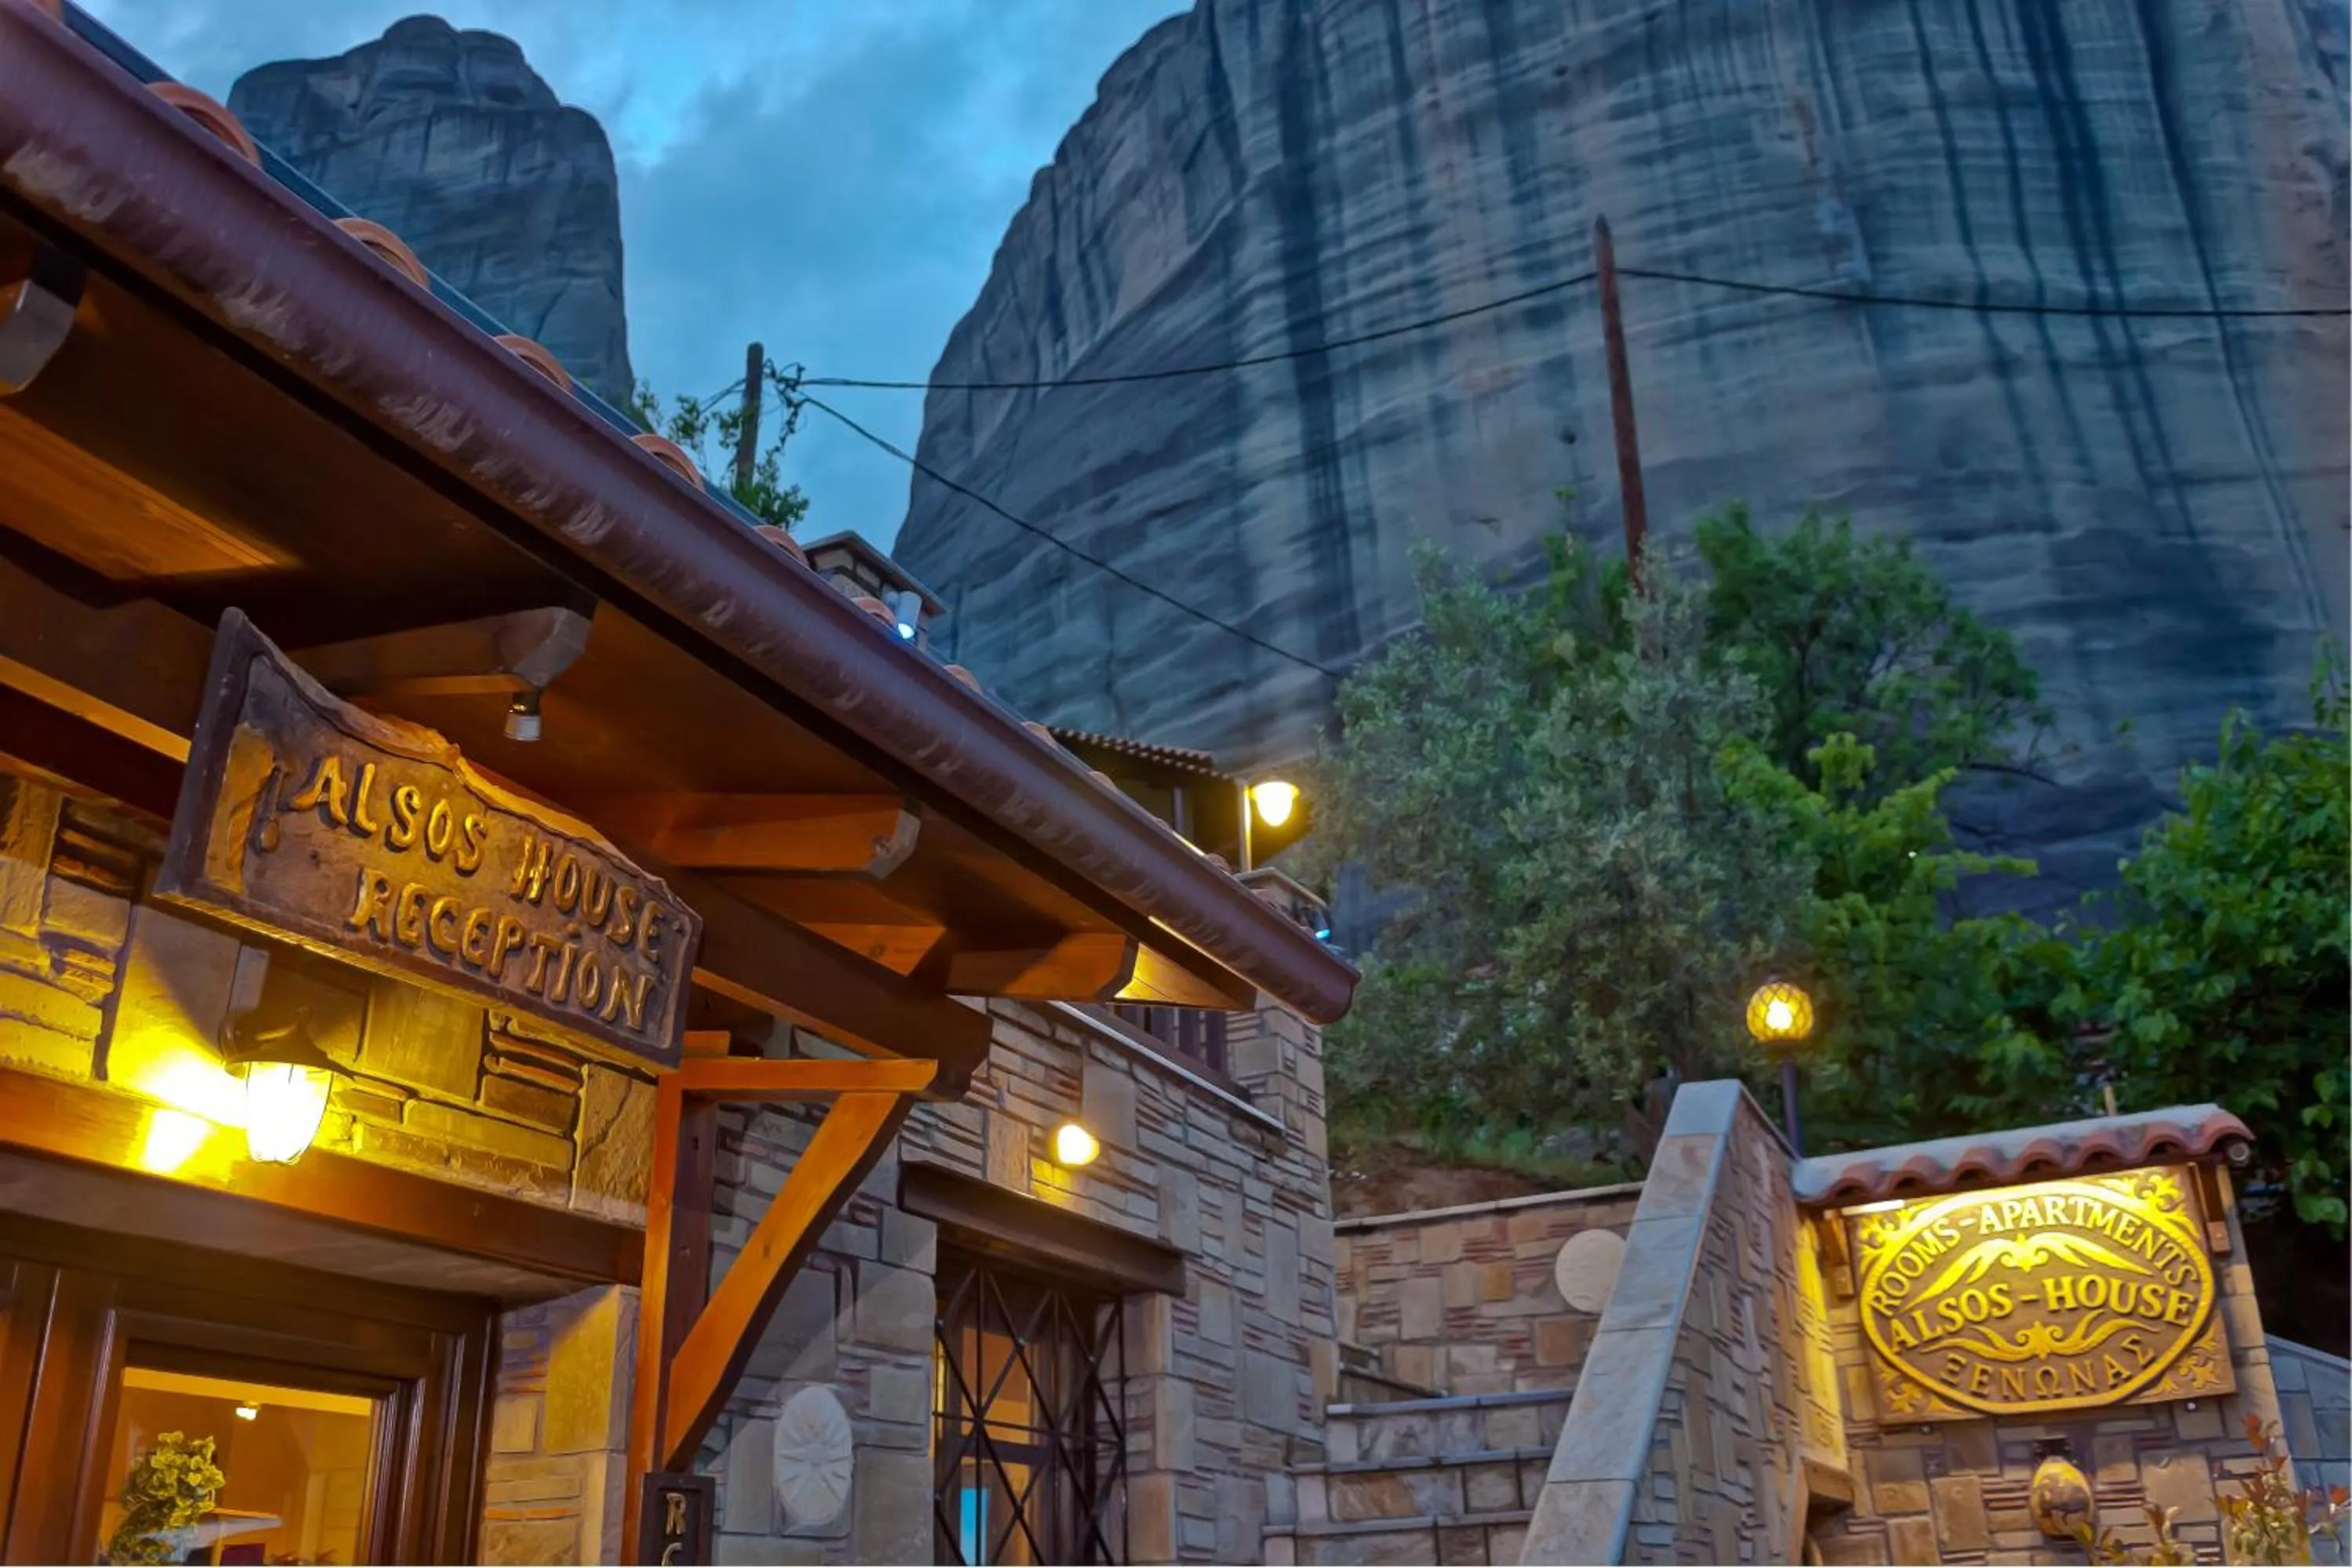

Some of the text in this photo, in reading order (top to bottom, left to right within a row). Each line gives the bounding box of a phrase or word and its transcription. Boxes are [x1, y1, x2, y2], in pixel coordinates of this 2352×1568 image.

[289, 755, 666, 961] ALSOS HOUSE
[347, 868, 652, 1031] RECEPTION
